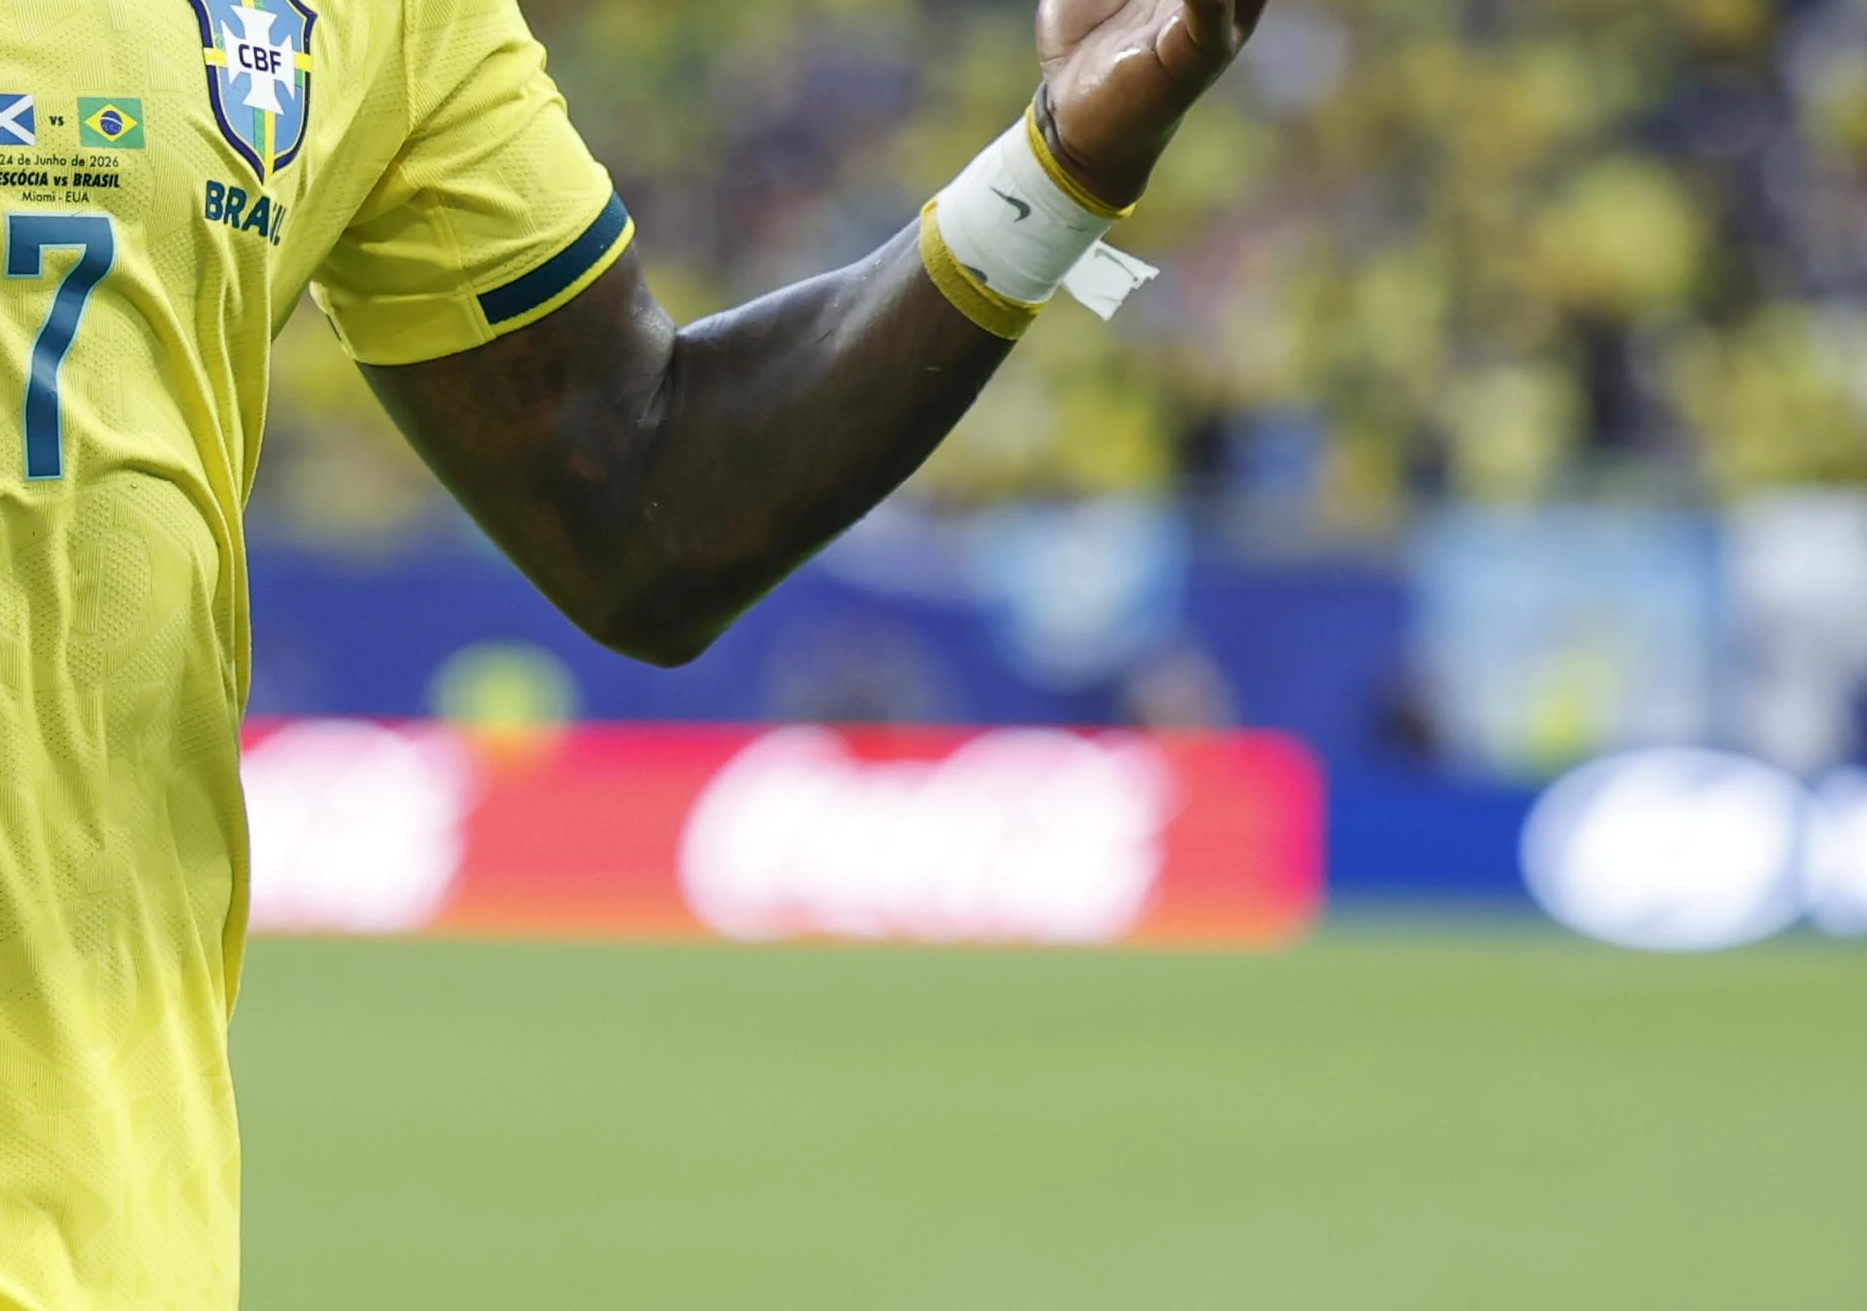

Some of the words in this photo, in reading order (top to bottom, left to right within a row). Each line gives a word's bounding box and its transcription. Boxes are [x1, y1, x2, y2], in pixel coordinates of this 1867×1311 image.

[238, 43, 281, 74] CBF
[49, 115, 64, 126] vs
[17, 153, 31, 165] de
[34, 153, 67, 166] Junho
[71, 154, 85, 167] de
[90, 155, 119, 167] 2026
[53, 175, 68, 186] vs
[73, 173, 120, 188] BRASIL
[22, 191, 56, 202] Miami
[65, 191, 90, 203] EUA
[205, 180, 286, 246] BRAIL
[4, 210, 116, 480] 7
